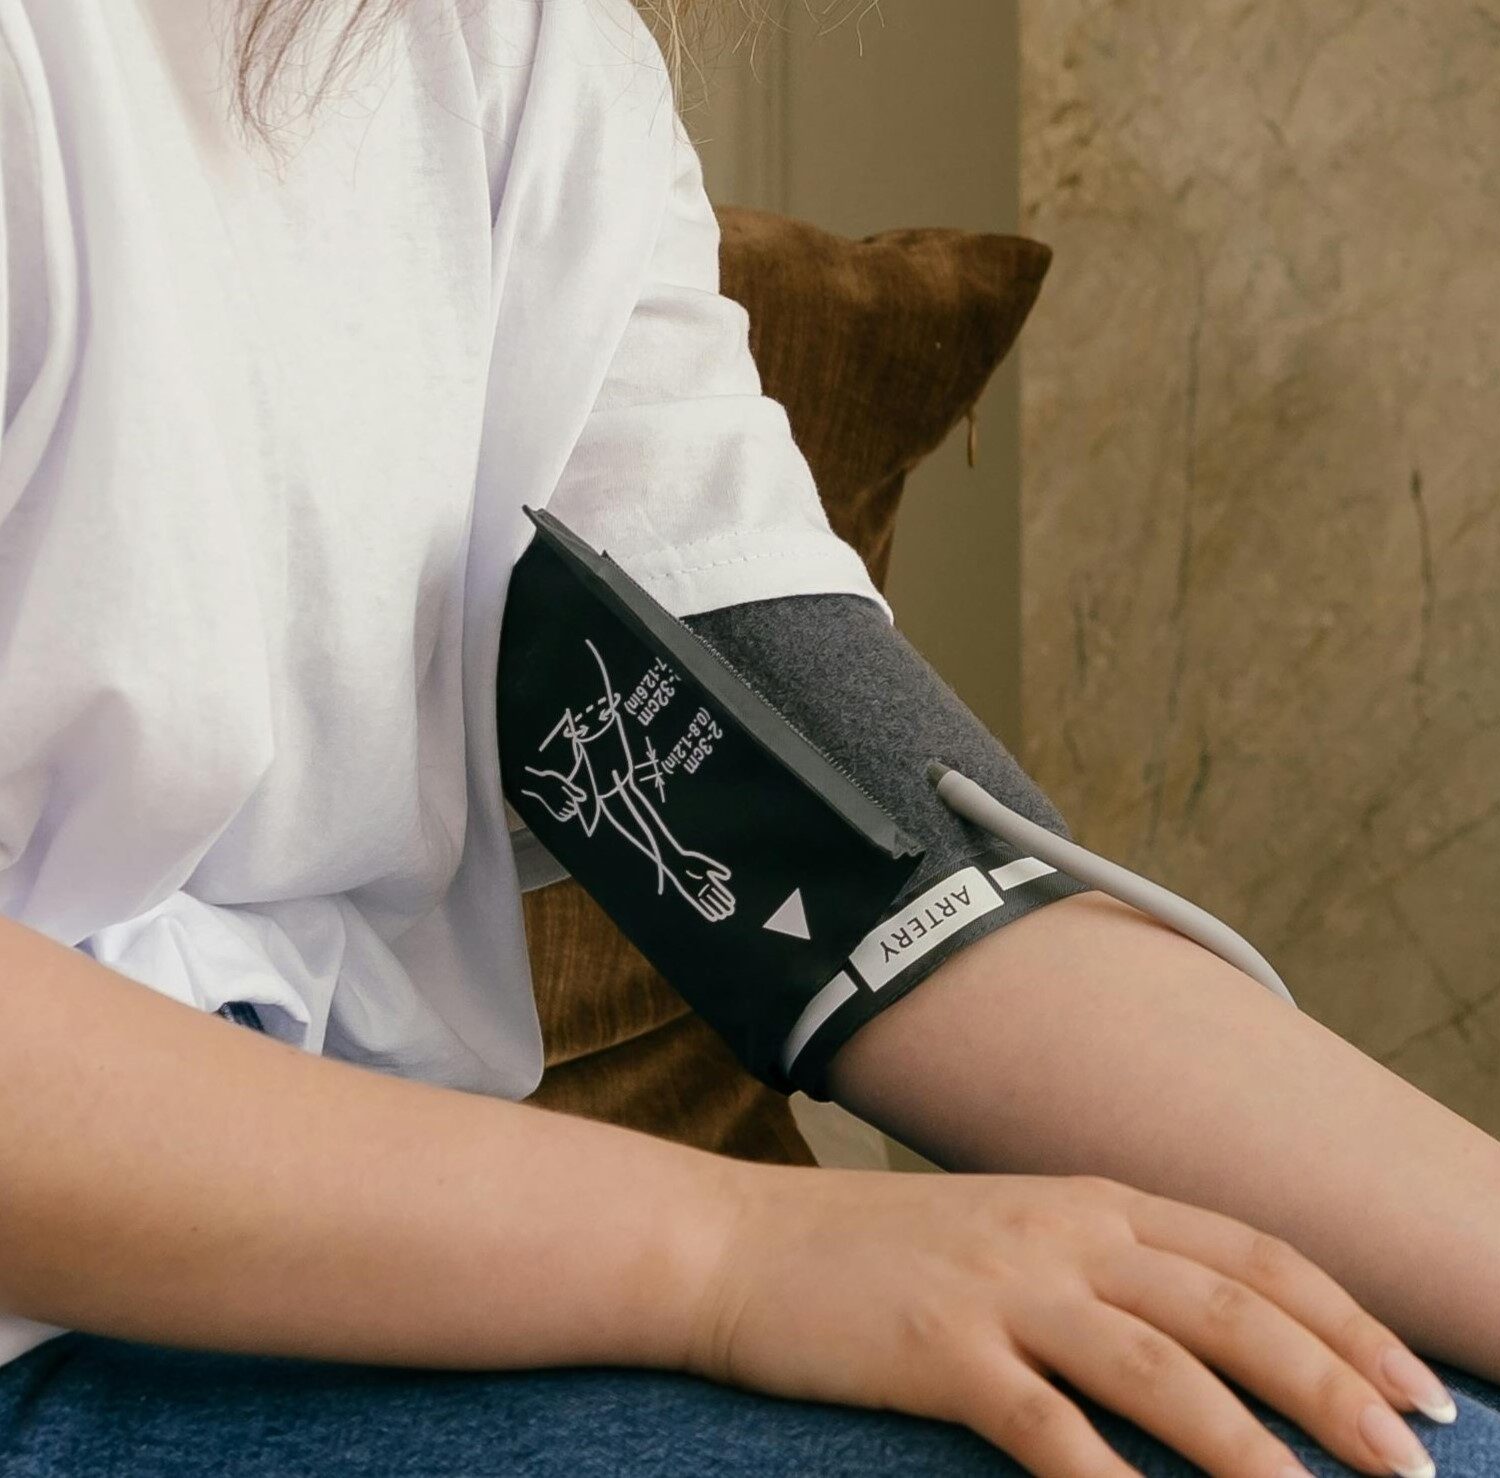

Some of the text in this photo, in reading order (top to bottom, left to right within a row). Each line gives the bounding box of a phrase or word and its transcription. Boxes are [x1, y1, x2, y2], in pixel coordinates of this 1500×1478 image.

[661, 707, 711, 774] (0.8-1.2in)
[684, 720, 723, 774] 2-3cm
[879, 885, 971, 963] ARTERY
